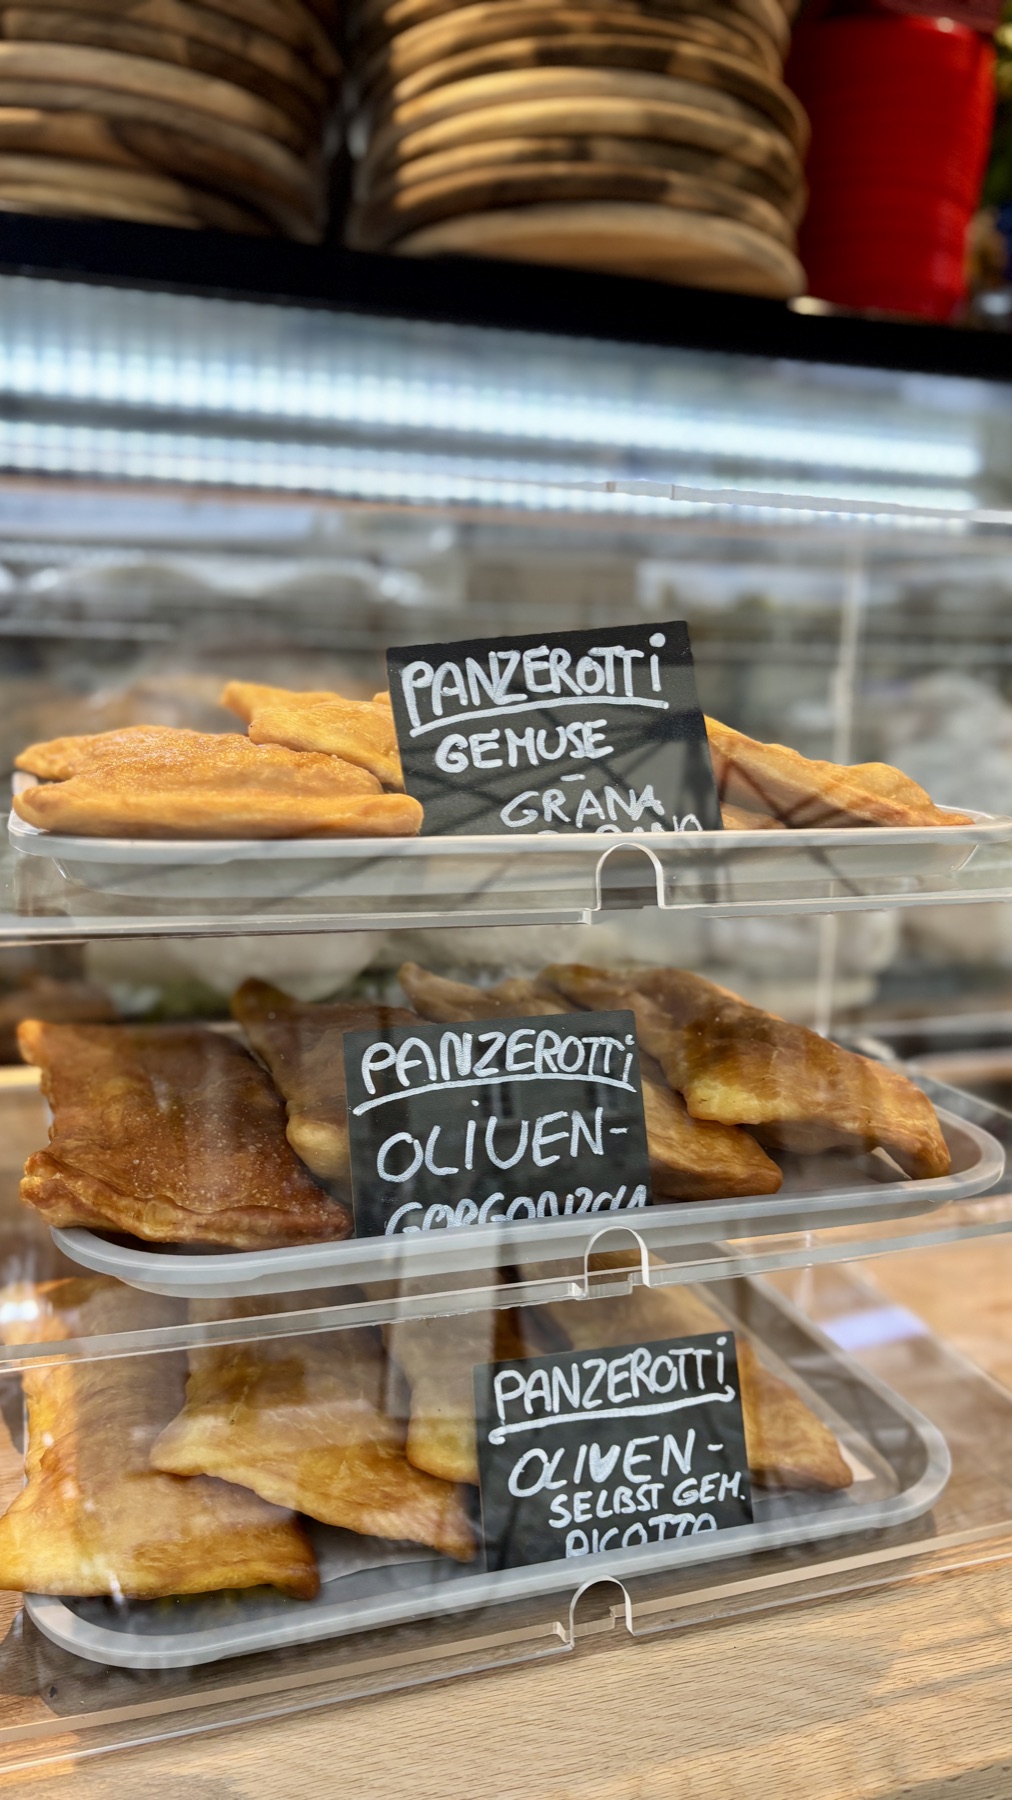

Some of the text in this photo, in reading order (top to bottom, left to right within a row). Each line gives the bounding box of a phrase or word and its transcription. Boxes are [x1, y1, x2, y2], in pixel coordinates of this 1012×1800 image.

[434, 719, 614, 773] GEMUSE
[500, 785, 665, 829] GRANA
[549, 1471, 746, 1528] SELBST GEM.
